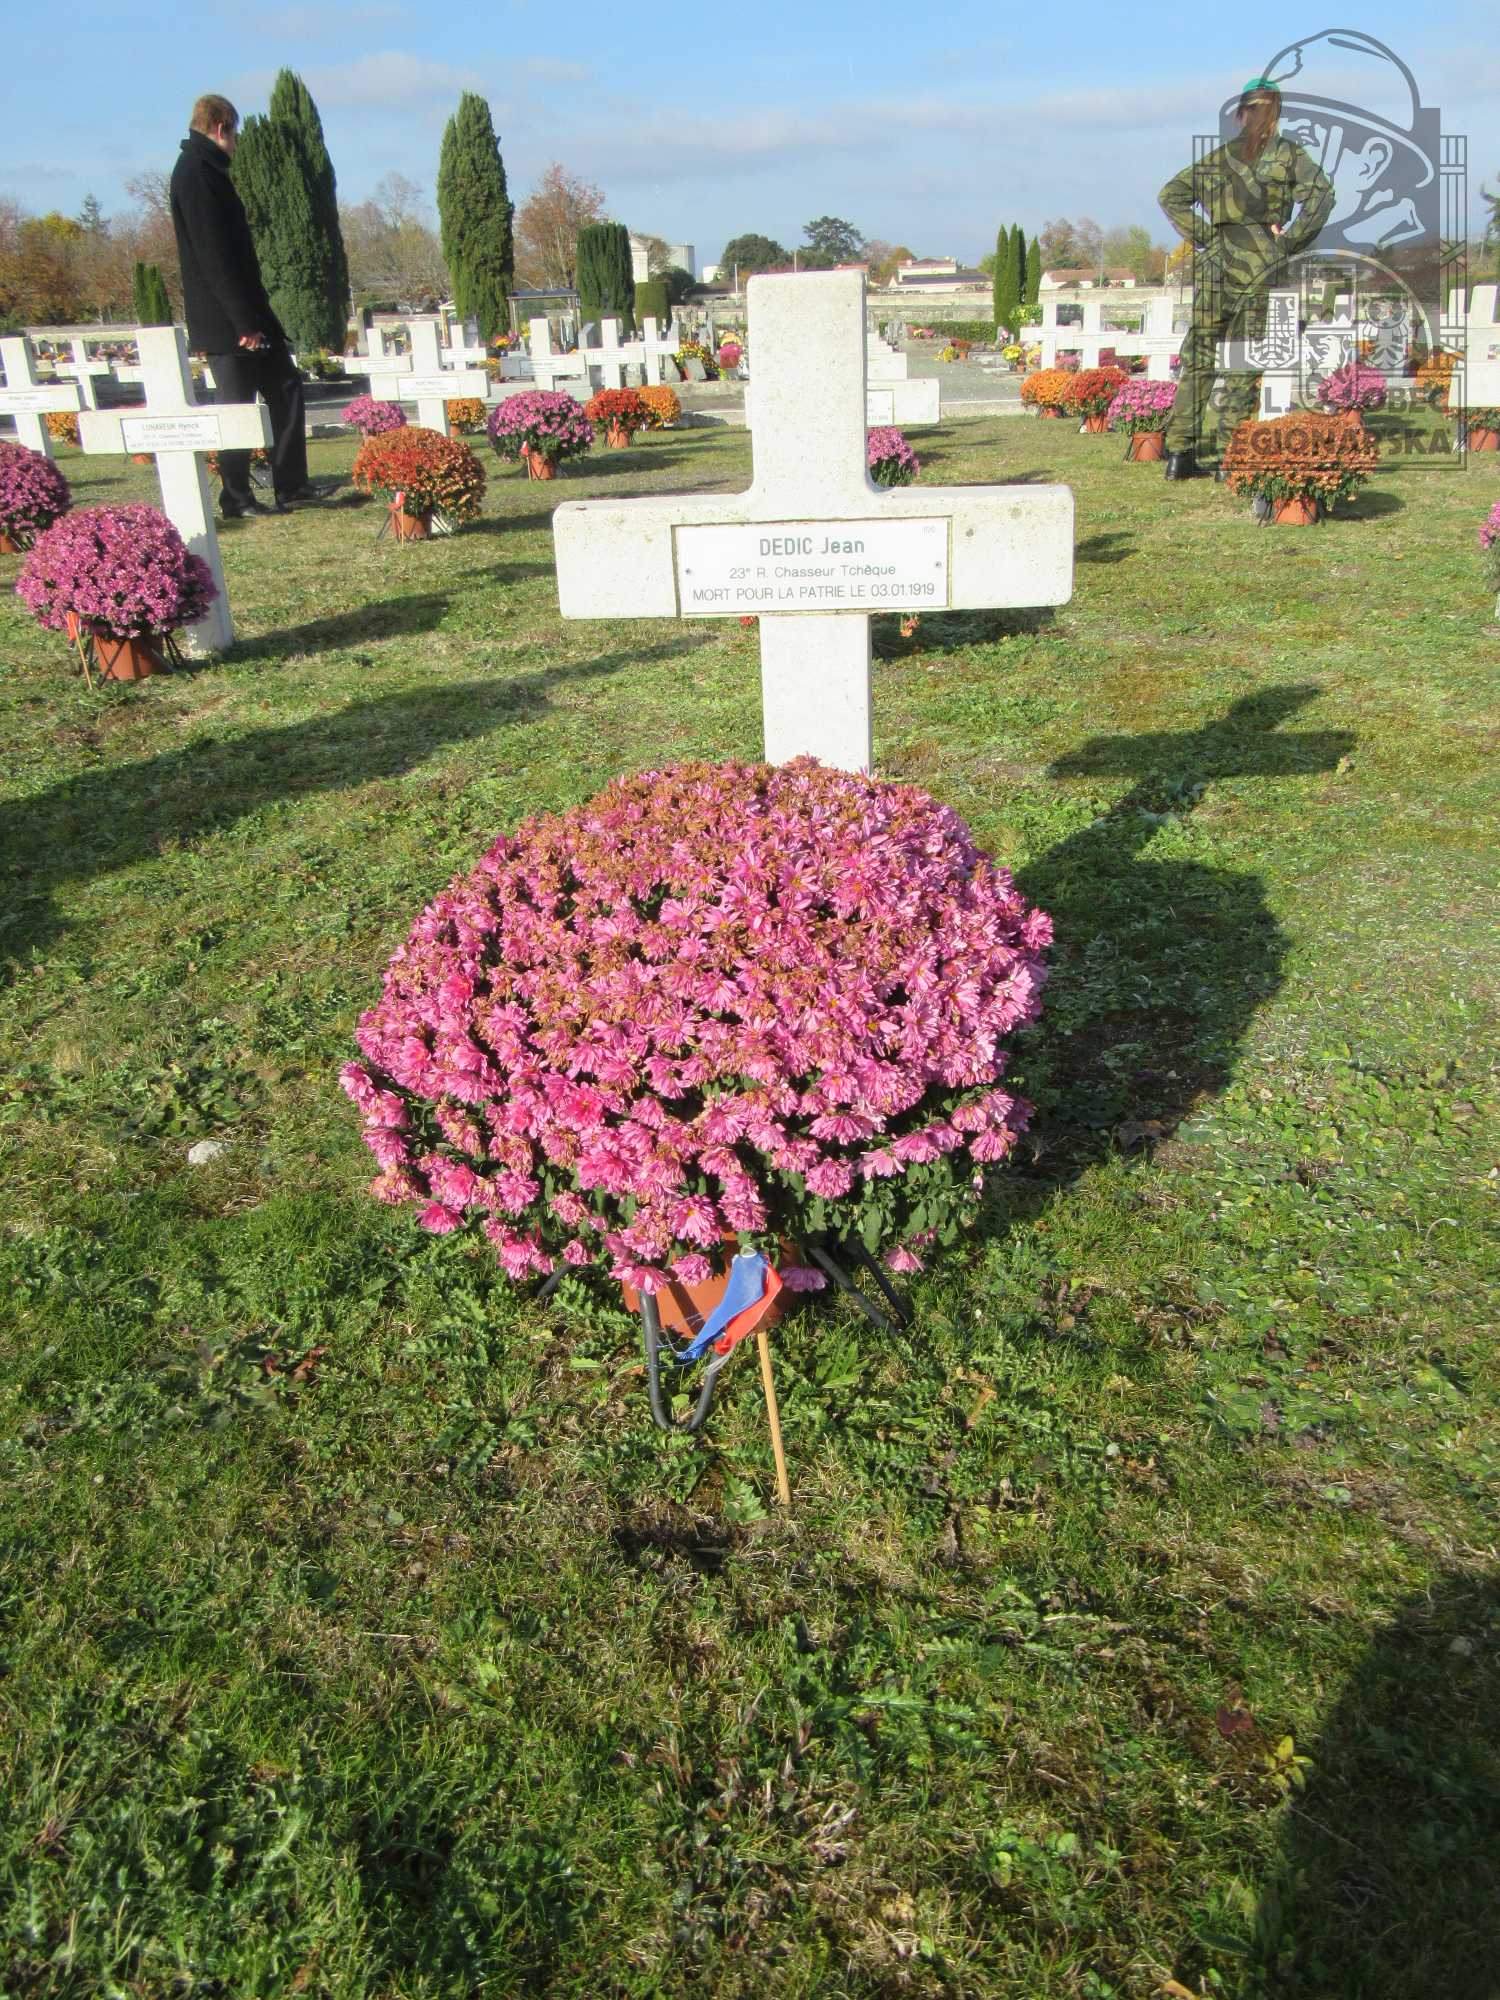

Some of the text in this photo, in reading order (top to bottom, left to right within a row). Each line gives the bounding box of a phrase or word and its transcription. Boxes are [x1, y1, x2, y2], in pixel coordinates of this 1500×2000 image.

[759, 536, 865, 556] DEDIC Jean
[774, 565, 835, 578] Chasseur
[840, 562, 896, 578] Tchèque
[692, 588, 731, 602] MORT
[736, 586, 774, 600] POUR
[778, 585, 794, 599] LA
[799, 585, 846, 599] PATRIE
[851, 584, 867, 597] LE
